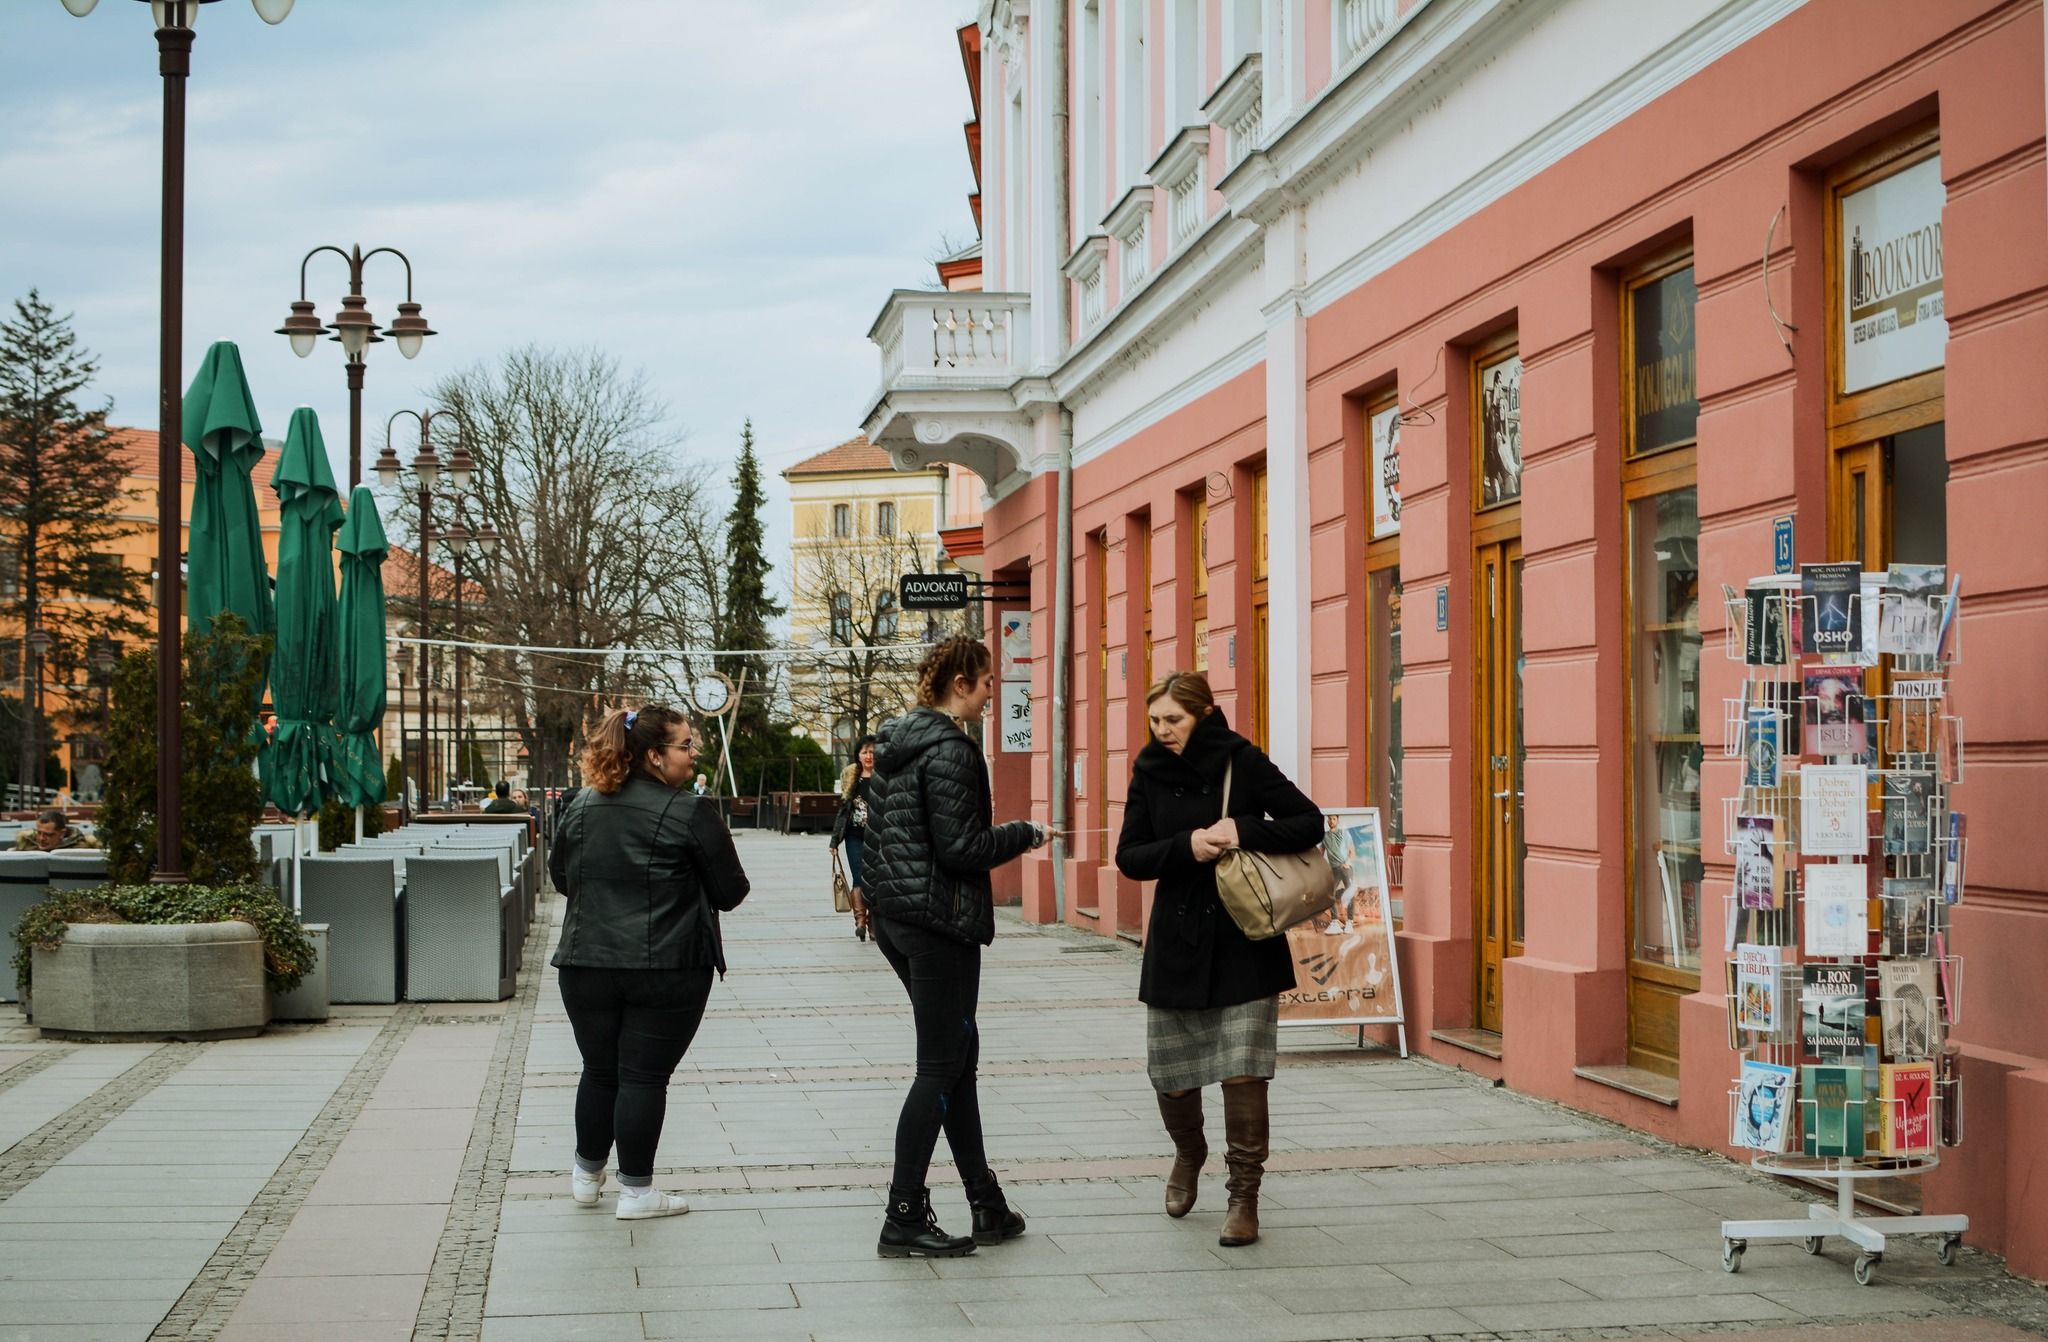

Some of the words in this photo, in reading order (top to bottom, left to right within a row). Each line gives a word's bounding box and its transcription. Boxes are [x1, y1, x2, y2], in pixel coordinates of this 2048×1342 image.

[1864, 222, 1943, 303] BOOKSTOR
[1779, 533, 1789, 561] 15
[905, 581, 963, 593] ADVOKATI
[908, 594, 942, 602] Ibrahimović
[943, 594, 949, 602] &
[1813, 631, 1853, 643] OSHO
[1897, 682, 1938, 697] DOSIJE
[1818, 776, 1850, 787] Dobre
[1816, 971, 1826, 983] L.
[1827, 971, 1851, 983] RON
[1811, 983, 1858, 996] HABARD
[1807, 1035, 1860, 1046] SAMOANALIZA
